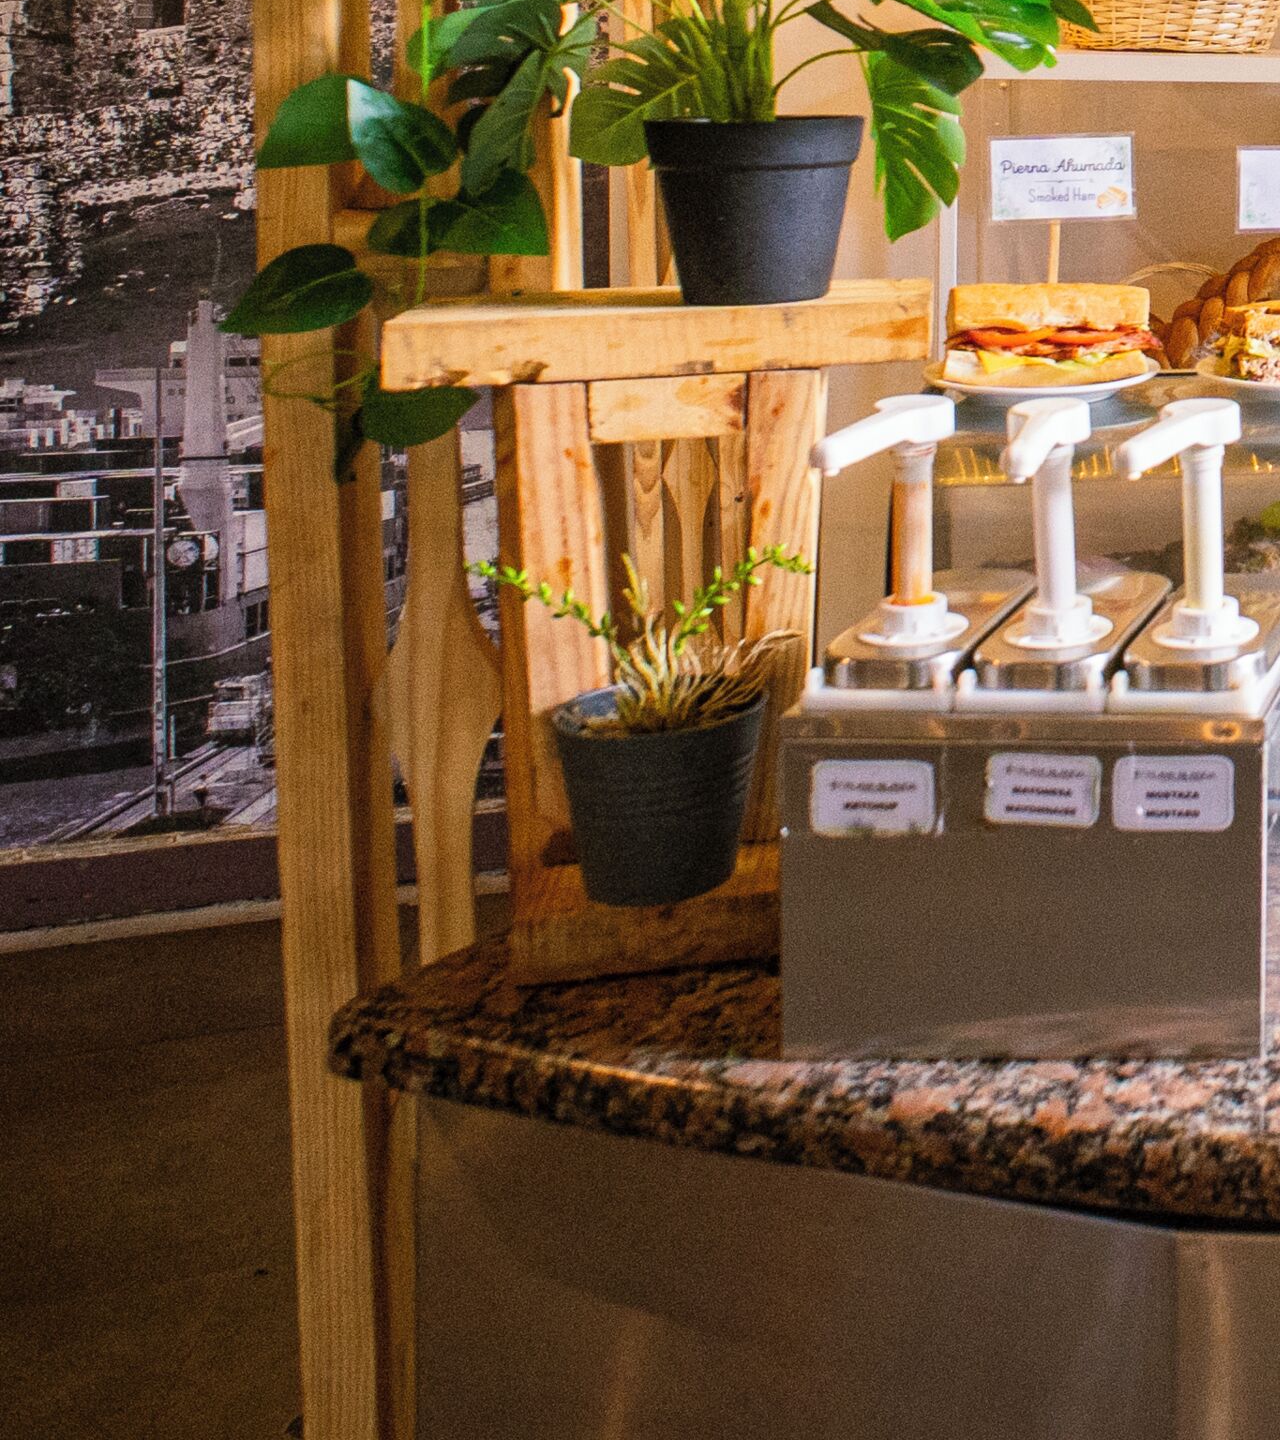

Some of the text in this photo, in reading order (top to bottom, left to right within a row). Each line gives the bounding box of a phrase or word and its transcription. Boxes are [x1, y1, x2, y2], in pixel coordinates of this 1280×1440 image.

[999, 157, 1126, 174] Pierna Ahumada
[1028, 187, 1096, 203] Smoked Ham
